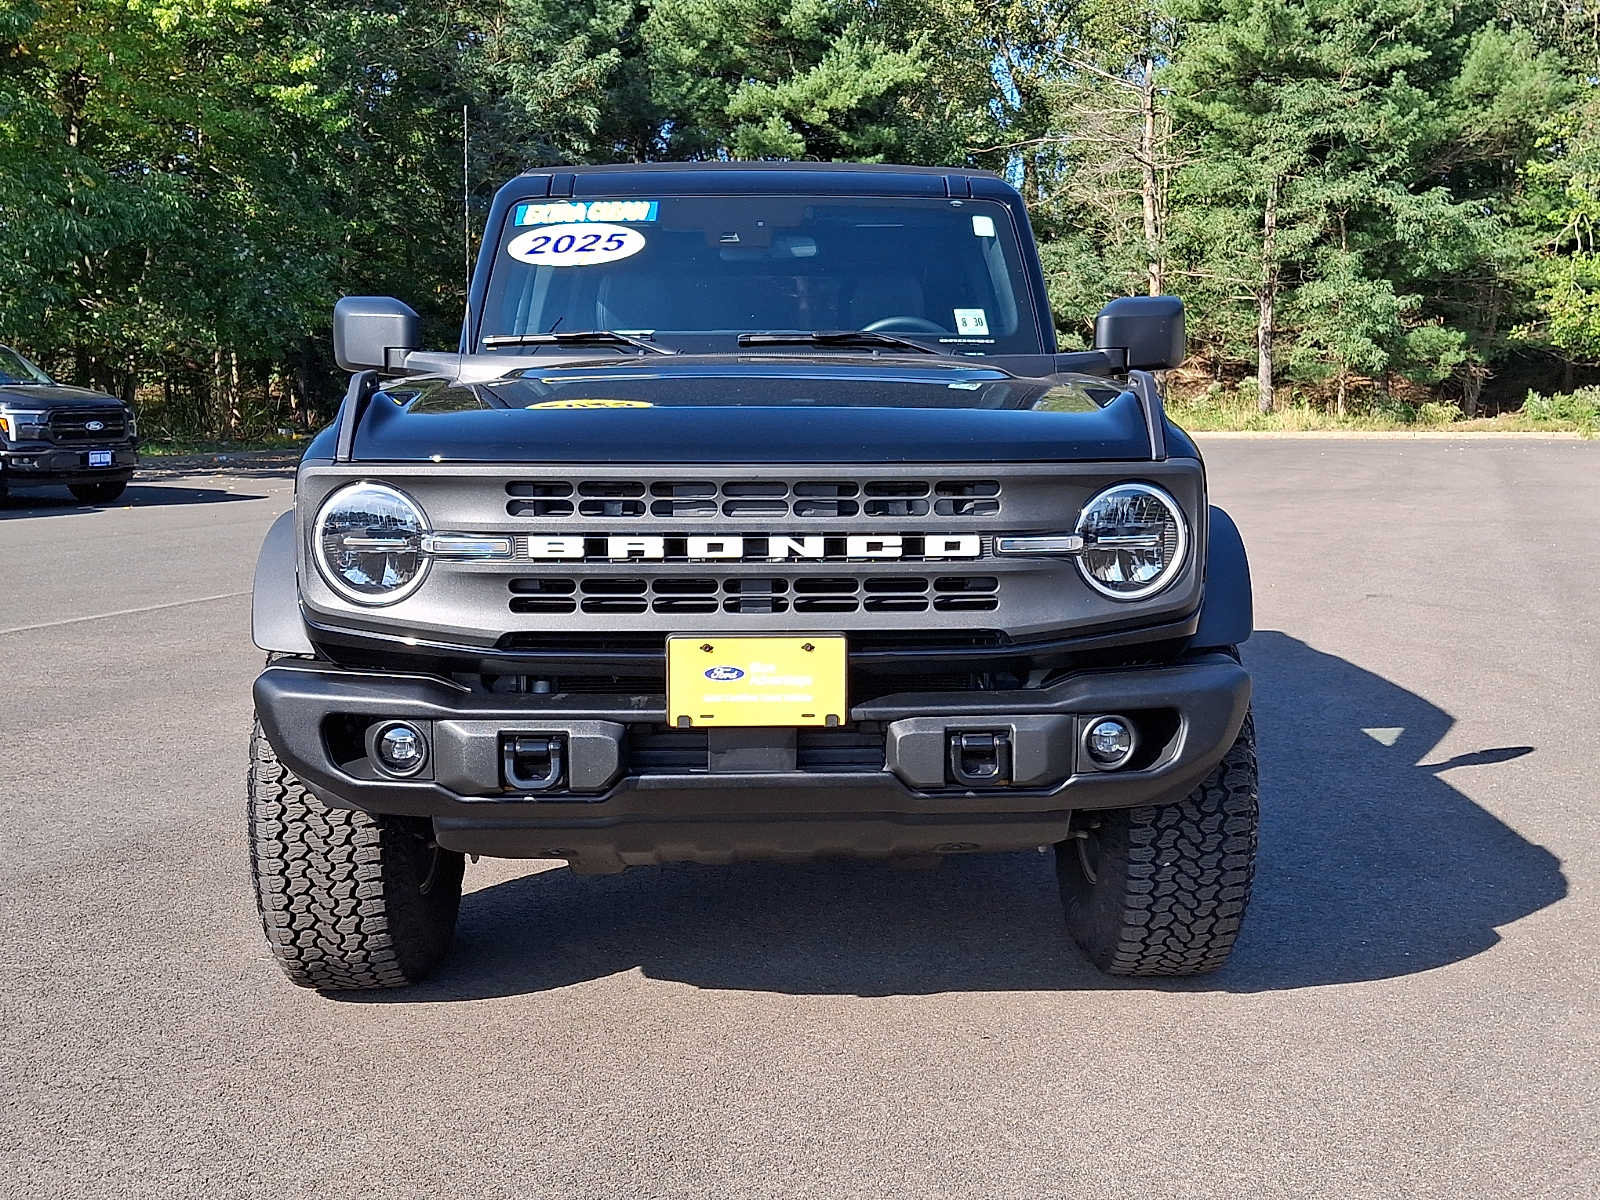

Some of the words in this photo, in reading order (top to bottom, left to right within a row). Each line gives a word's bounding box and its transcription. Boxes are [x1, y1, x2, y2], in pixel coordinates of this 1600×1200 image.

[525, 233, 628, 255] 2025
[528, 535, 981, 558] BRONCO
[708, 666, 740, 680] Ford
